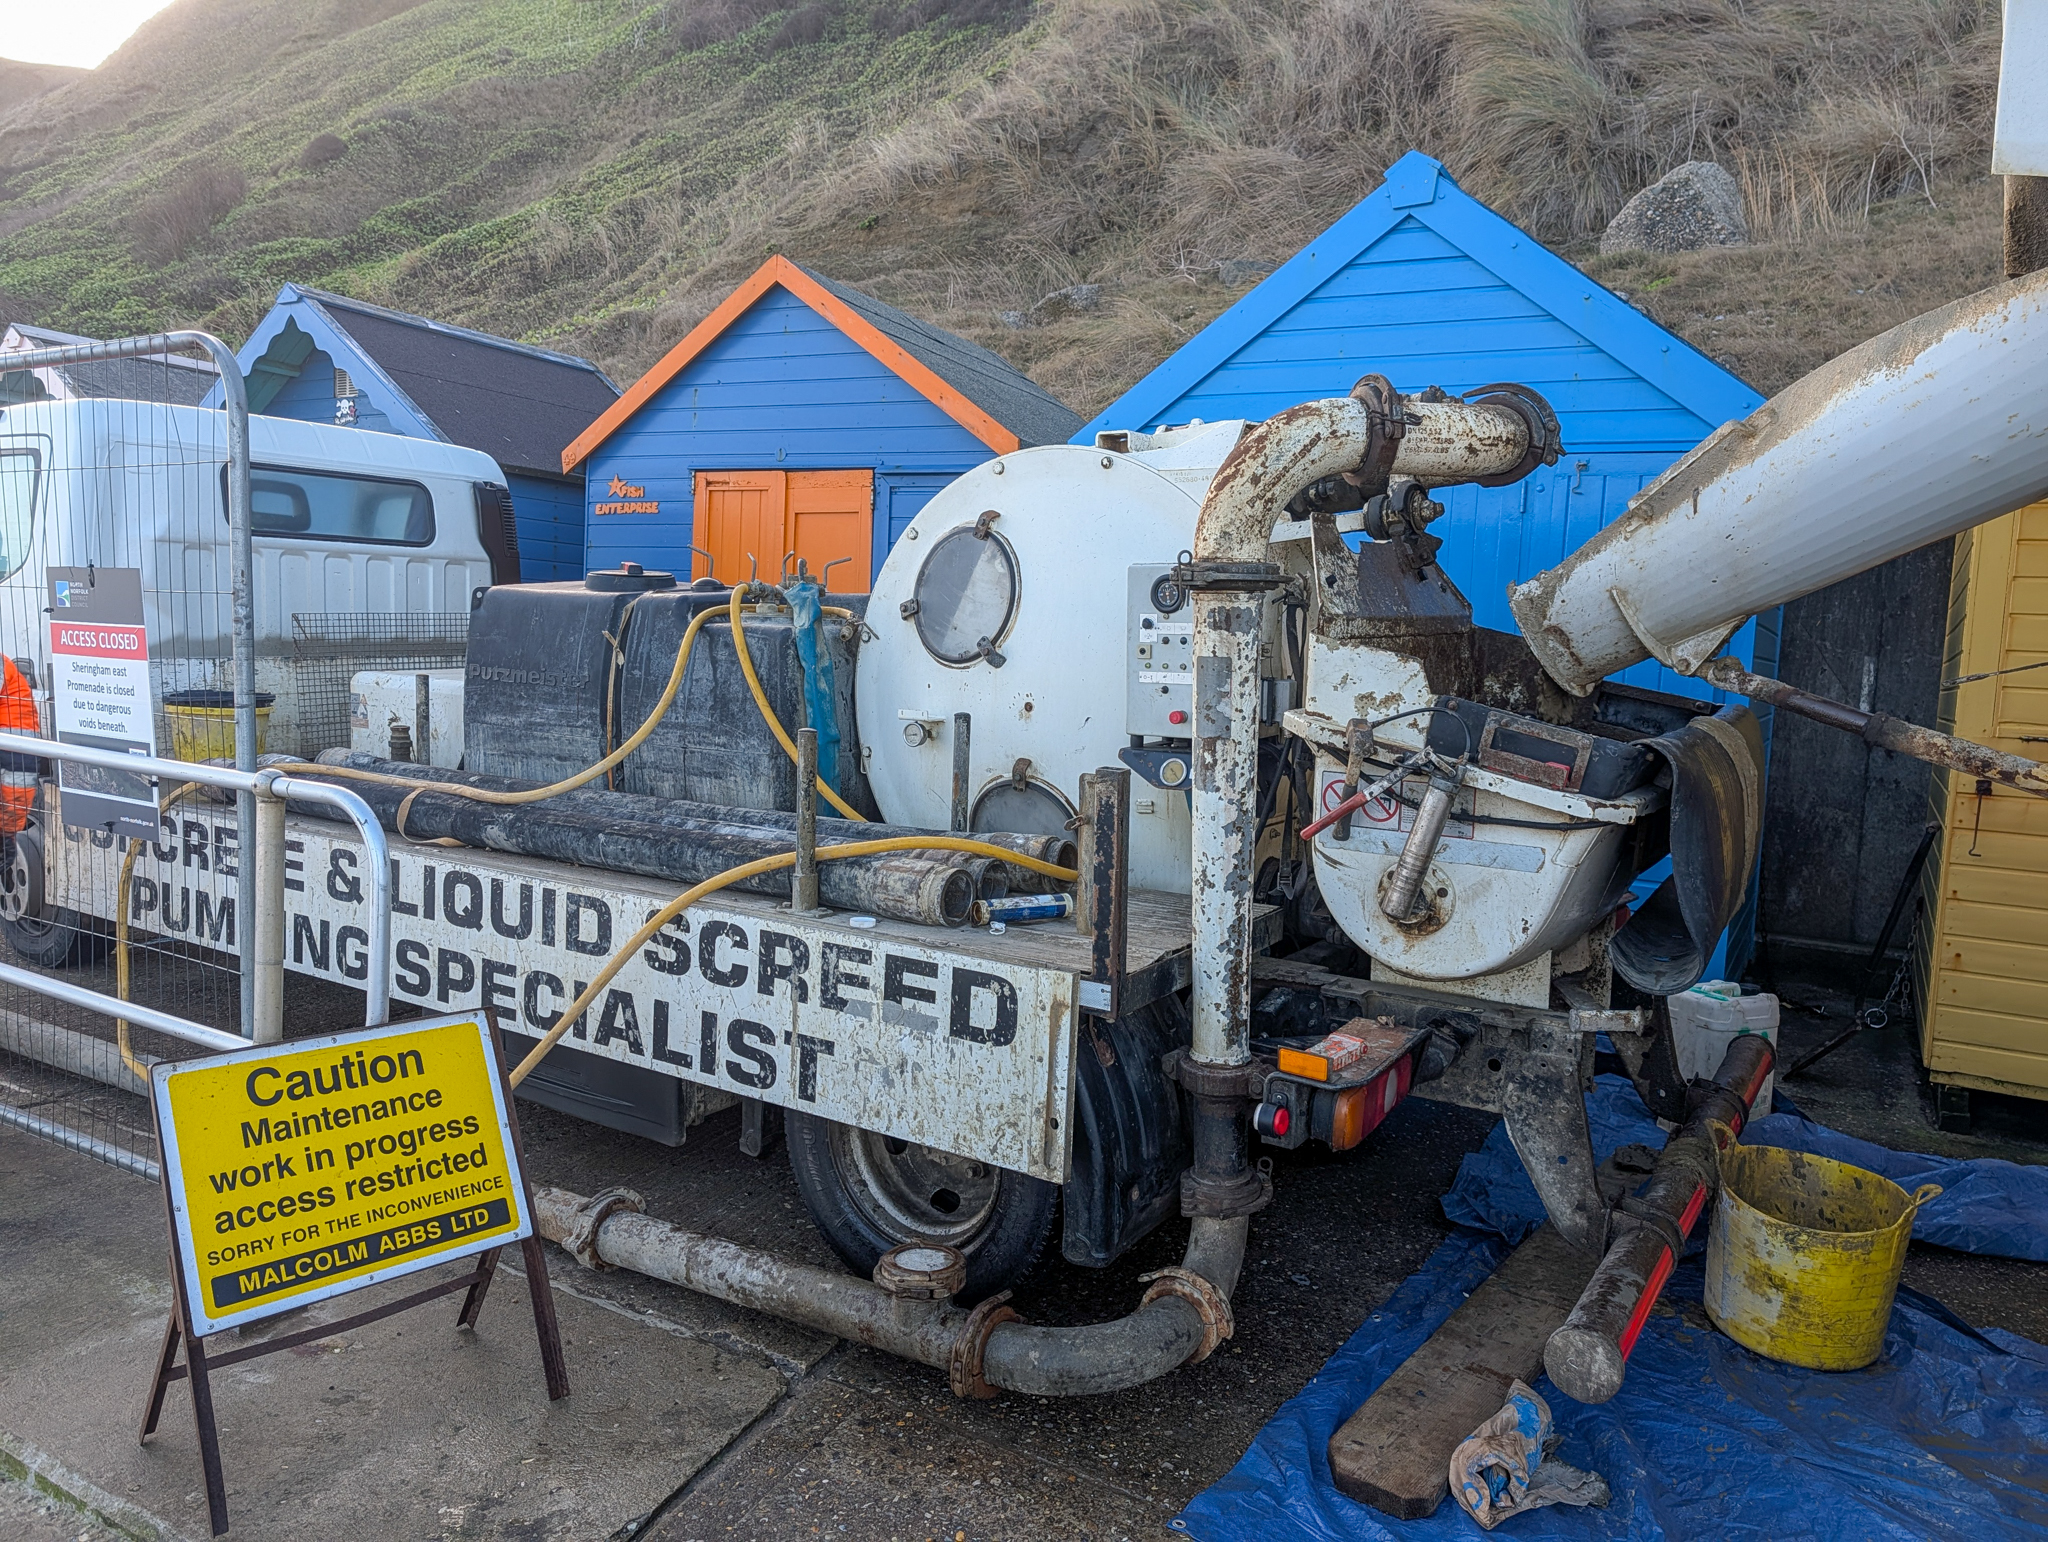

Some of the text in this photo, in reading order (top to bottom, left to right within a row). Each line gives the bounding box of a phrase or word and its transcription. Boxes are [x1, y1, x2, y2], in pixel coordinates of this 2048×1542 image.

[595, 501, 659, 515] ENTERPRISE
[620, 486, 645, 498] FISH
[60, 629, 138, 650] ACCESS CLOSED
[67, 679, 135, 697] Promenade is closed
[71, 661, 127, 677] Sheringham east
[468, 663, 590, 689] Putzmeister
[73, 698, 131, 715] due to dangerous
[78, 717, 128, 733] voids beneath.
[326, 848, 365, 905] &
[391, 858, 613, 957] LIQUID
[644, 908, 1018, 1047] SCREED
[132, 874, 835, 1103] PUMNG SPECIALIST
[245, 1049, 425, 1107] Caution
[240, 1088, 443, 1149] Maintenance
[209, 1114, 480, 1195] work in progress
[214, 1142, 489, 1234] access restricted
[207, 1175, 504, 1266] SORRY FOR THE INCONVENIENCE
[238, 1207, 490, 1295] MALCOLM ABBS LTD
